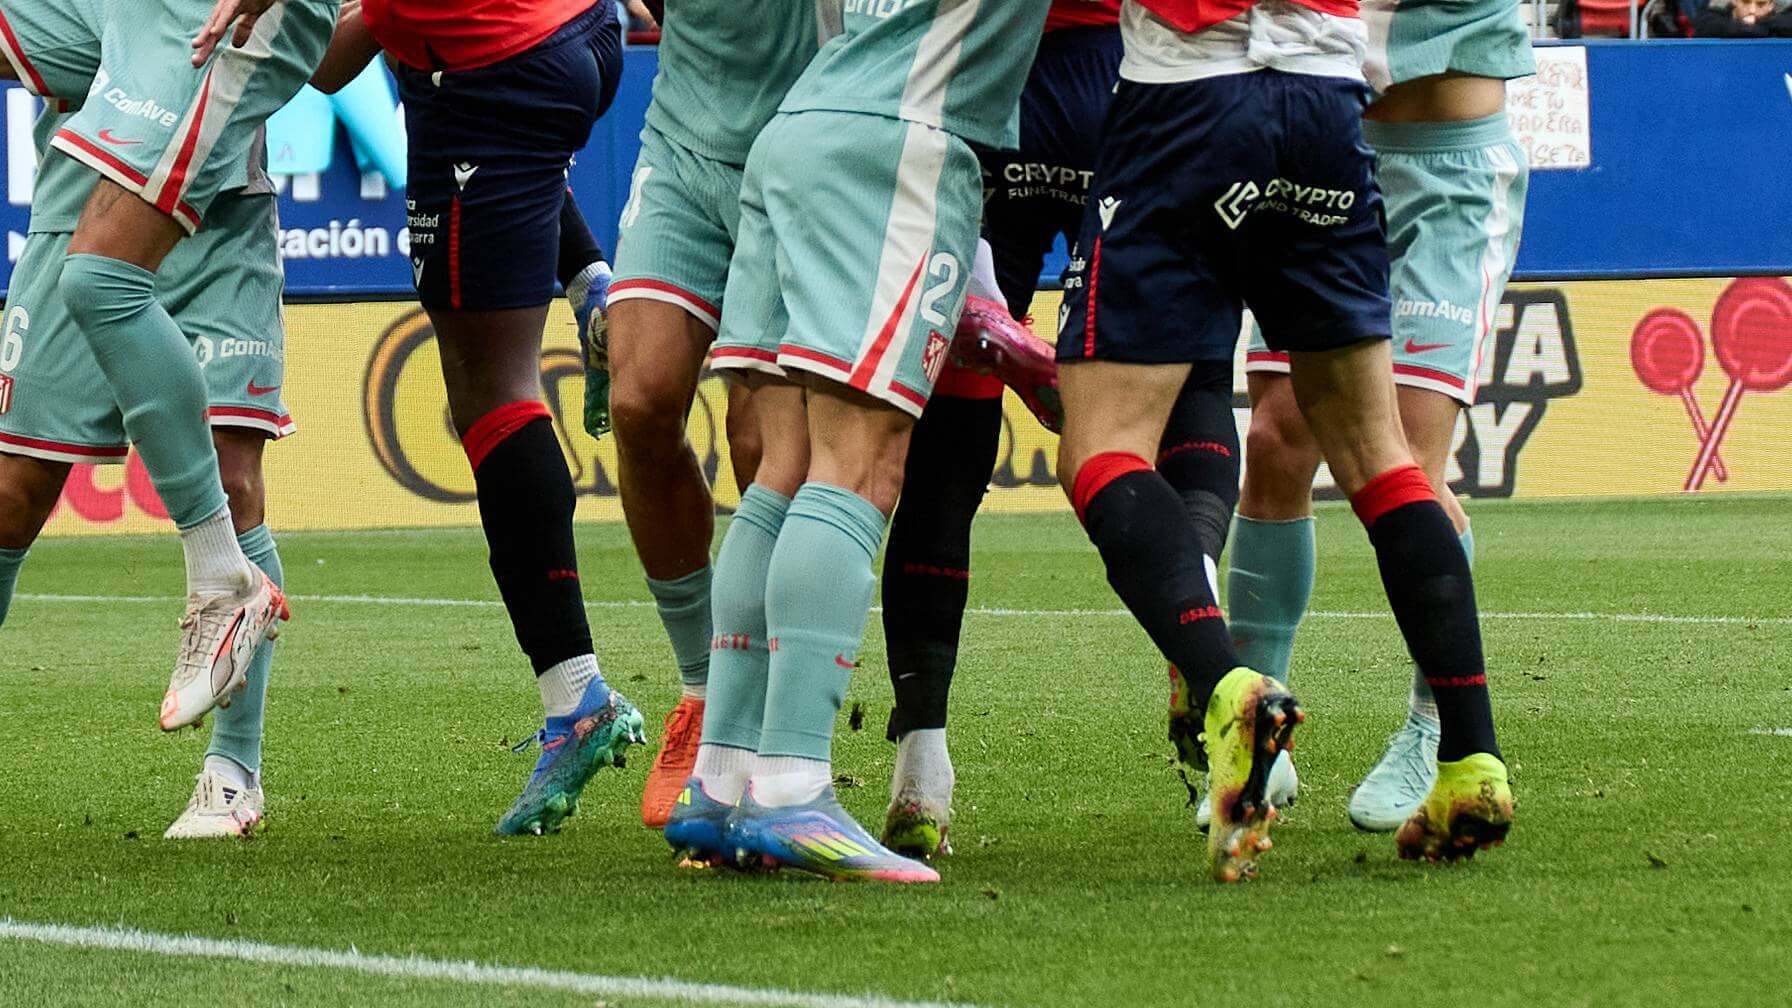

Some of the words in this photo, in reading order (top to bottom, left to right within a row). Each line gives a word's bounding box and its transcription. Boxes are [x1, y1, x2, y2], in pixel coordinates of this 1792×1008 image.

[104, 87, 179, 127] ComAve
[1004, 162, 1095, 190] CRYPT
[1264, 177, 1356, 211] CRYPTO
[0, 305, 30, 372] 6
